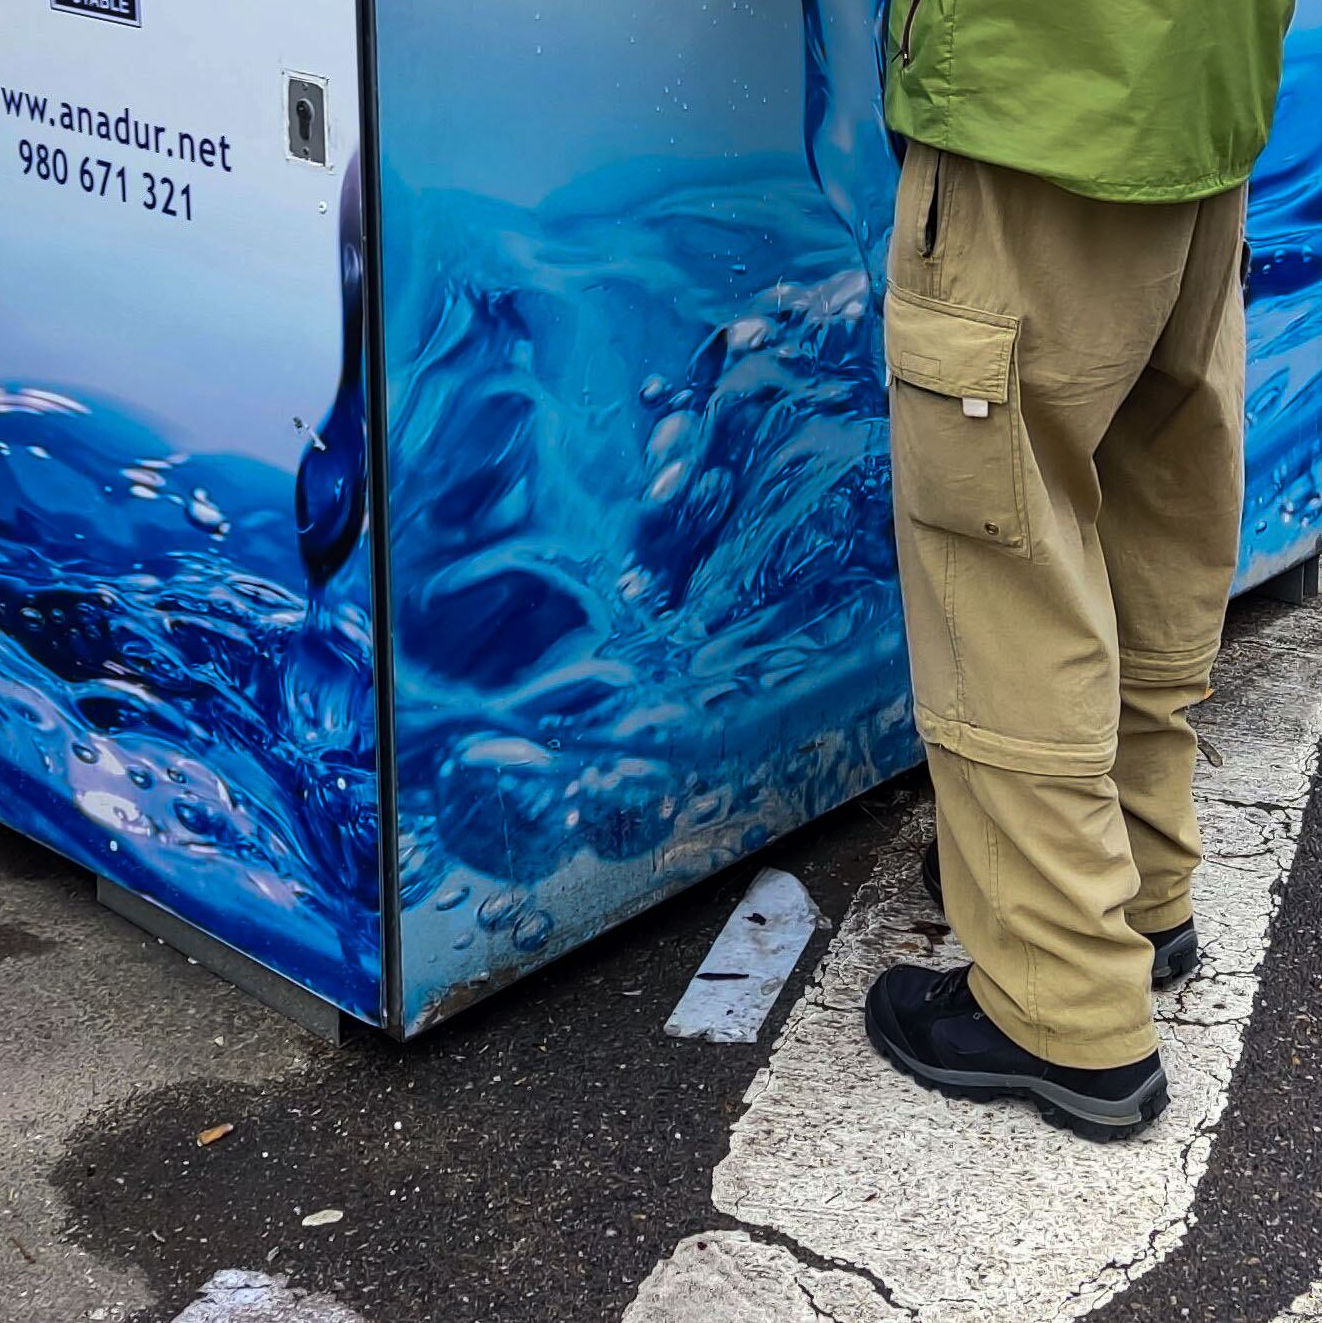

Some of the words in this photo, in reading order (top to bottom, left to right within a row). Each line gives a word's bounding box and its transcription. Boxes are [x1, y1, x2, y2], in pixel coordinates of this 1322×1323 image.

[18, 139, 69, 185] 980
[80, 156, 127, 203] 671
[142, 172, 193, 221] 321
